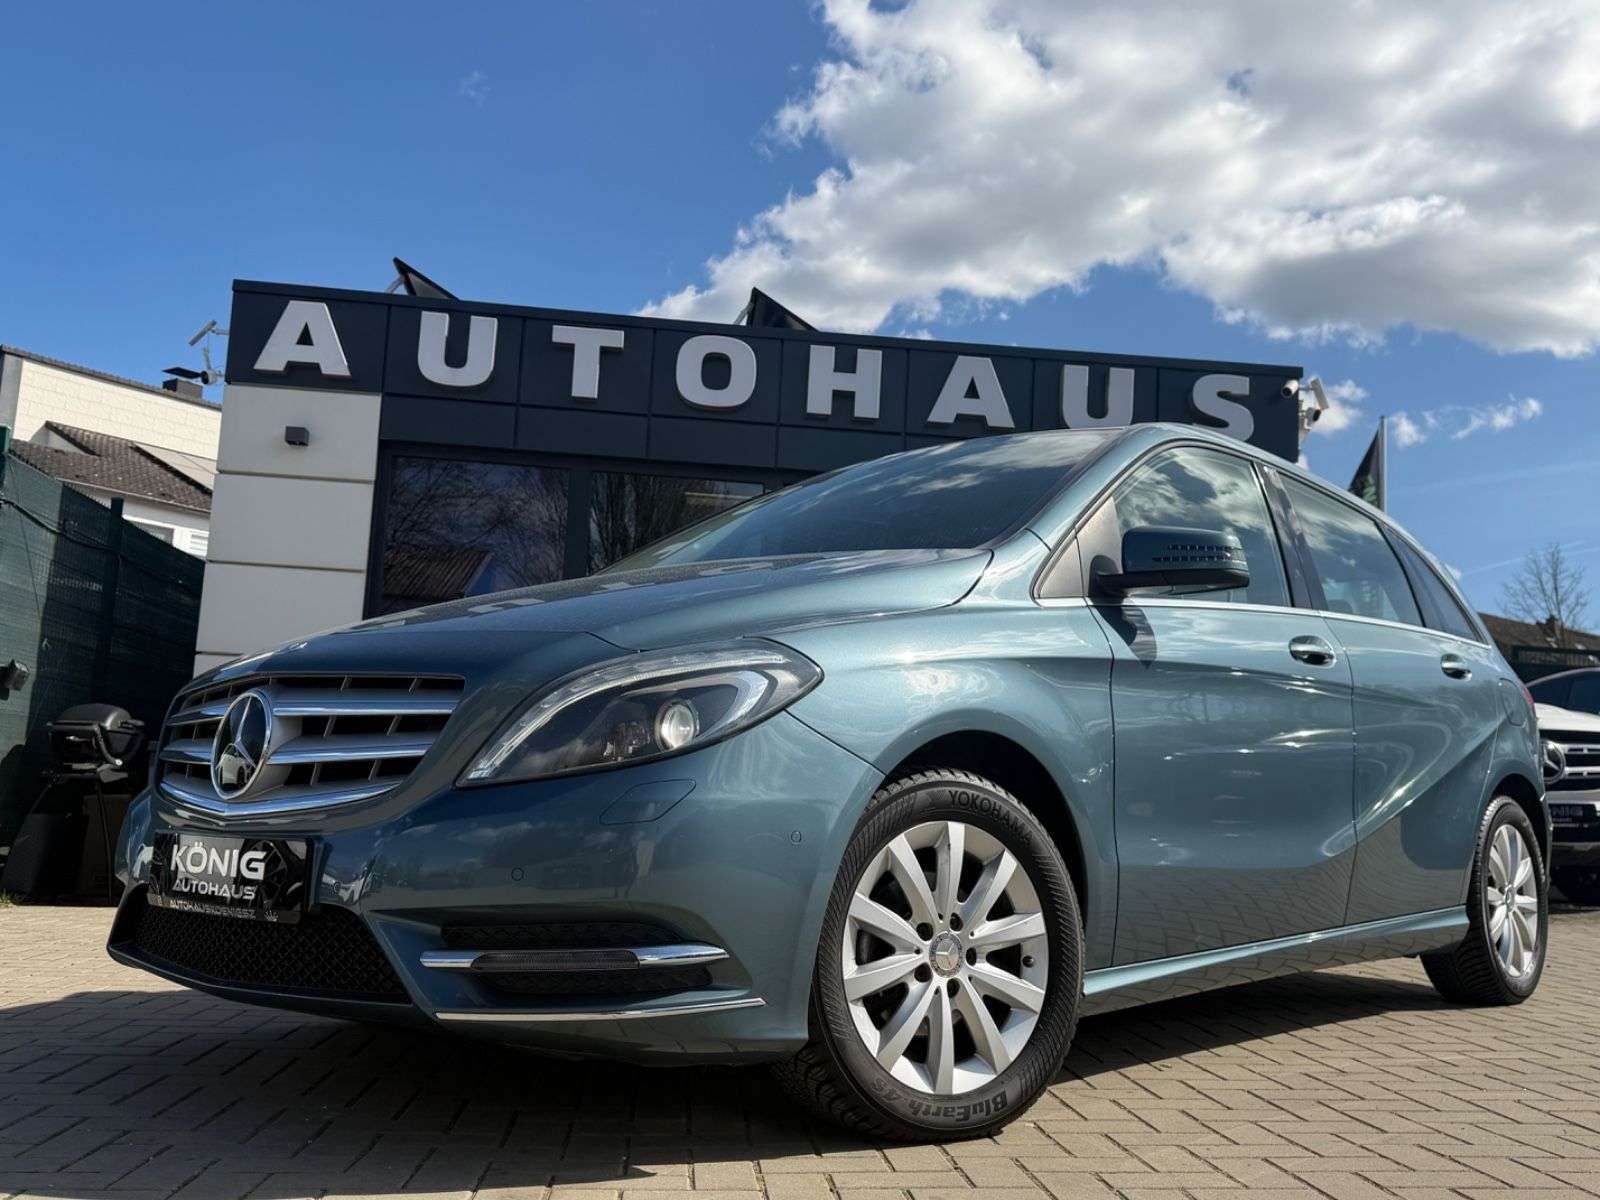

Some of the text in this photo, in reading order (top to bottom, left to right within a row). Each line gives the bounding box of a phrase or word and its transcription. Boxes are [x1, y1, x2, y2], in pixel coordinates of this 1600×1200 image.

[254, 300, 1254, 441] AUTOHAUS
[948, 790, 1033, 846] YOKOHAMA
[171, 842, 267, 880] KÖNIG
[172, 877, 257, 900] AUTOHAUS
